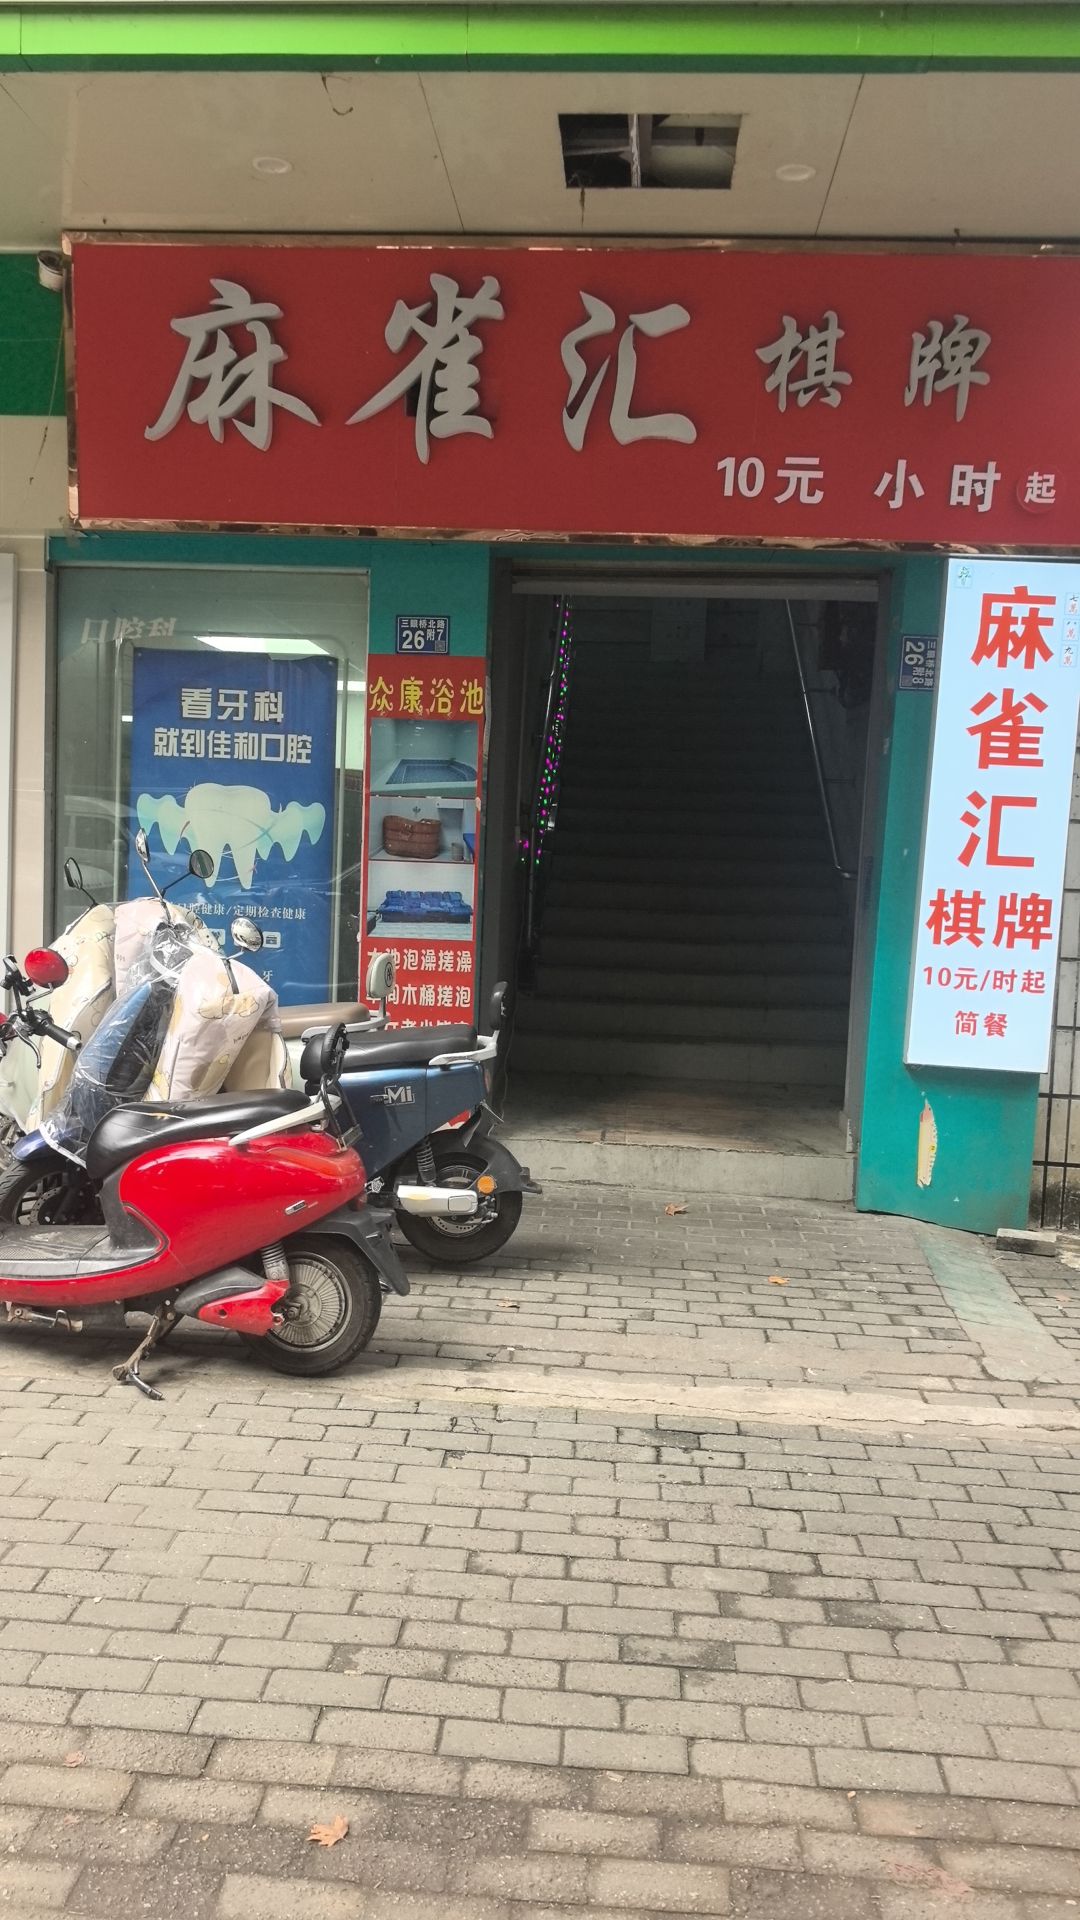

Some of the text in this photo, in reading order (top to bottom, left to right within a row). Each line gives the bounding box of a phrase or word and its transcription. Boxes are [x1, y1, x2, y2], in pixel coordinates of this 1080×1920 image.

[144, 272, 992, 465] 麻雀汇 棋牌
[402, 630, 425, 650] 26
[904, 641, 925, 665] 26
[180, 687, 285, 723] 看牙科
[369, 676, 484, 716] 众康浴池
[957, 585, 1057, 868] 麻雀汇
[153, 727, 313, 765] 就到佳和口腔
[926, 888, 1053, 950] 棋牌
[923, 966, 1047, 994] 10元/时起
[954, 1010, 1009, 1038] 简餐
